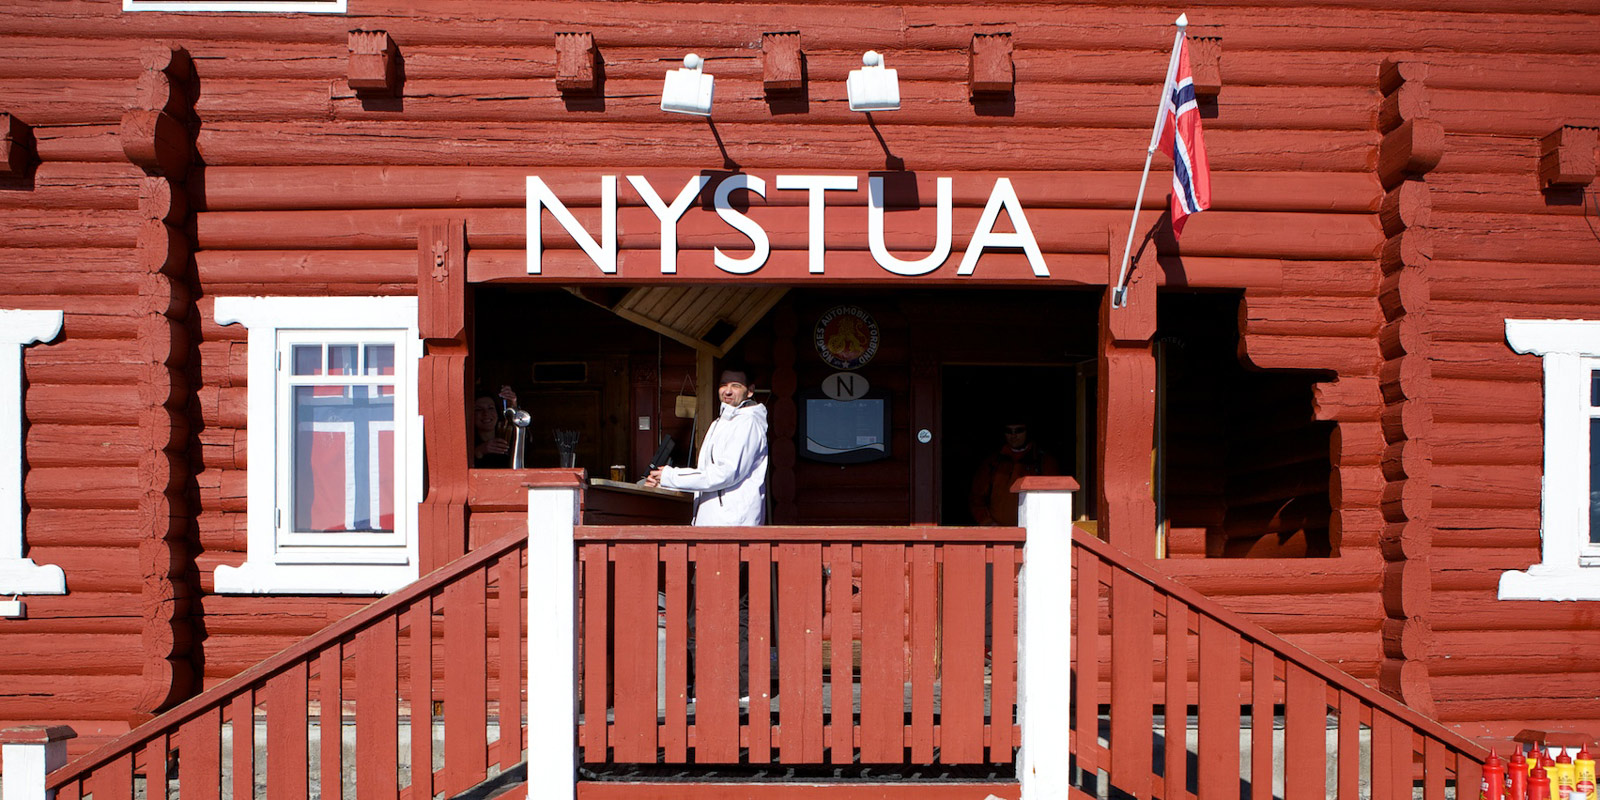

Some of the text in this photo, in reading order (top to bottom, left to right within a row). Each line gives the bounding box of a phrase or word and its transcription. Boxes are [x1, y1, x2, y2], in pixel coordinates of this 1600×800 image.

[525, 174, 1050, 277] NYSTUA
[816, 307, 878, 364] NORGES AUTOMOBIL-FORBUND
[837, 375, 854, 397] N
